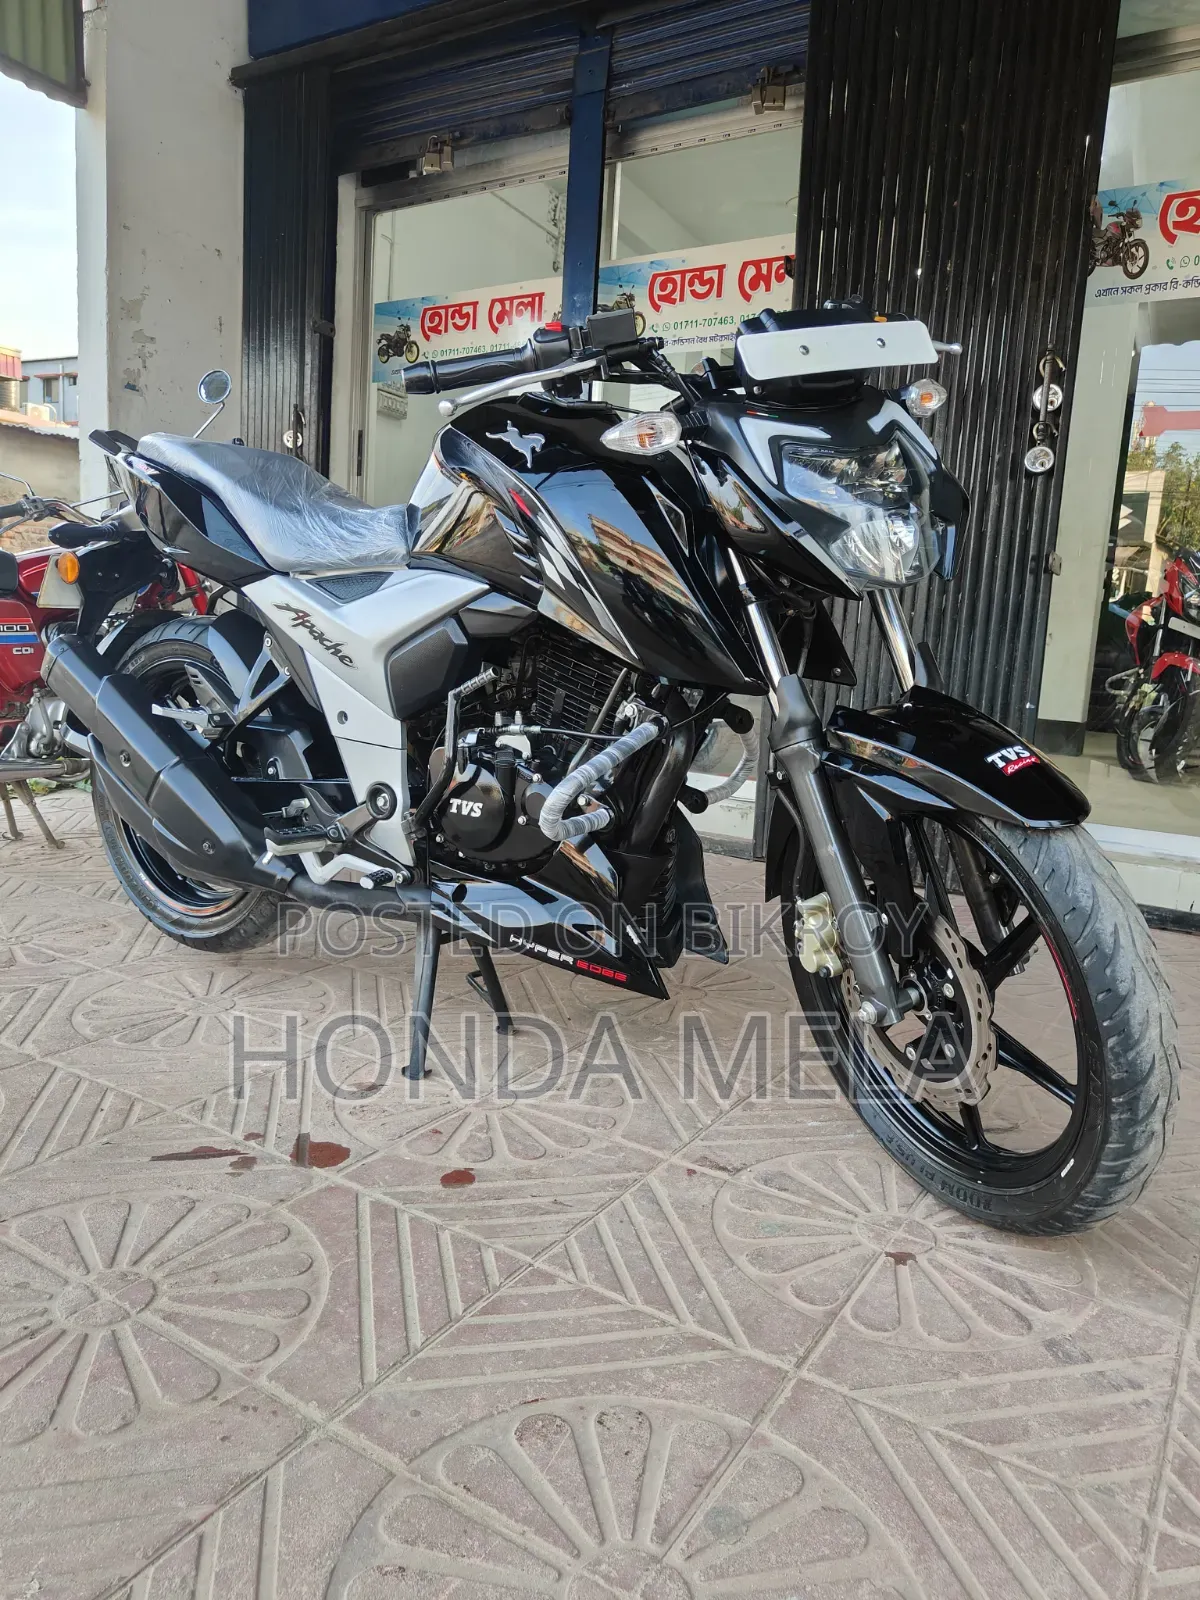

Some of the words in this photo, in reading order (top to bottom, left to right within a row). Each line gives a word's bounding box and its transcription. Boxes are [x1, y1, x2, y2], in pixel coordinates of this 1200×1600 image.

[648, 264, 727, 313] হোন্ডা
[1094, 286, 1119, 298] এখানে
[1120, 284, 1143, 294] সকল
[1144, 281, 1169, 295] প্রকার
[420, 301, 479, 342] হোন্ডা
[488, 292, 546, 335] মেলা
[272, 603, 358, 669] Apache
[986, 745, 1031, 769] TVS
[449, 797, 484, 818] TVS
[509, 933, 574, 966] HYPER
[576, 959, 628, 982] EDGE
